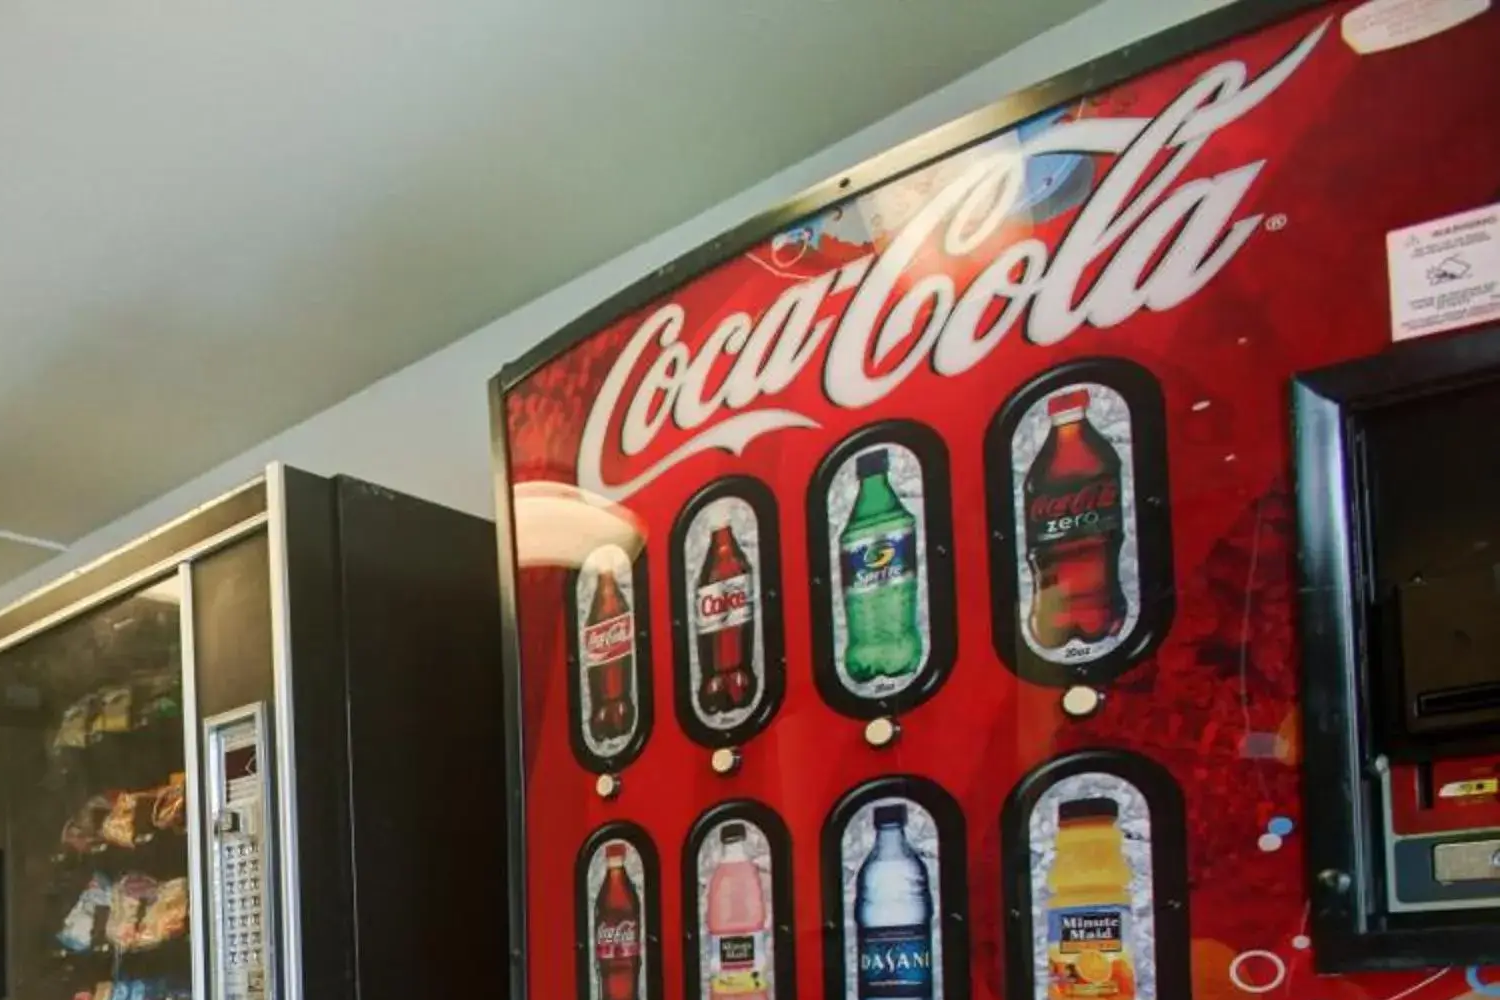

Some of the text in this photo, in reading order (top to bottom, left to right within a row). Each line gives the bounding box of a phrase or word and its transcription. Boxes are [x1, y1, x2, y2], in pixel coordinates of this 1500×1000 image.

[577, 15, 1333, 502] Coca-Cola
[1047, 510, 1099, 533] zero
[701, 591, 747, 617] Coke
[1062, 917, 1120, 930] Minute
[1069, 927, 1113, 940] Maid
[861, 946, 931, 973] DASANI
